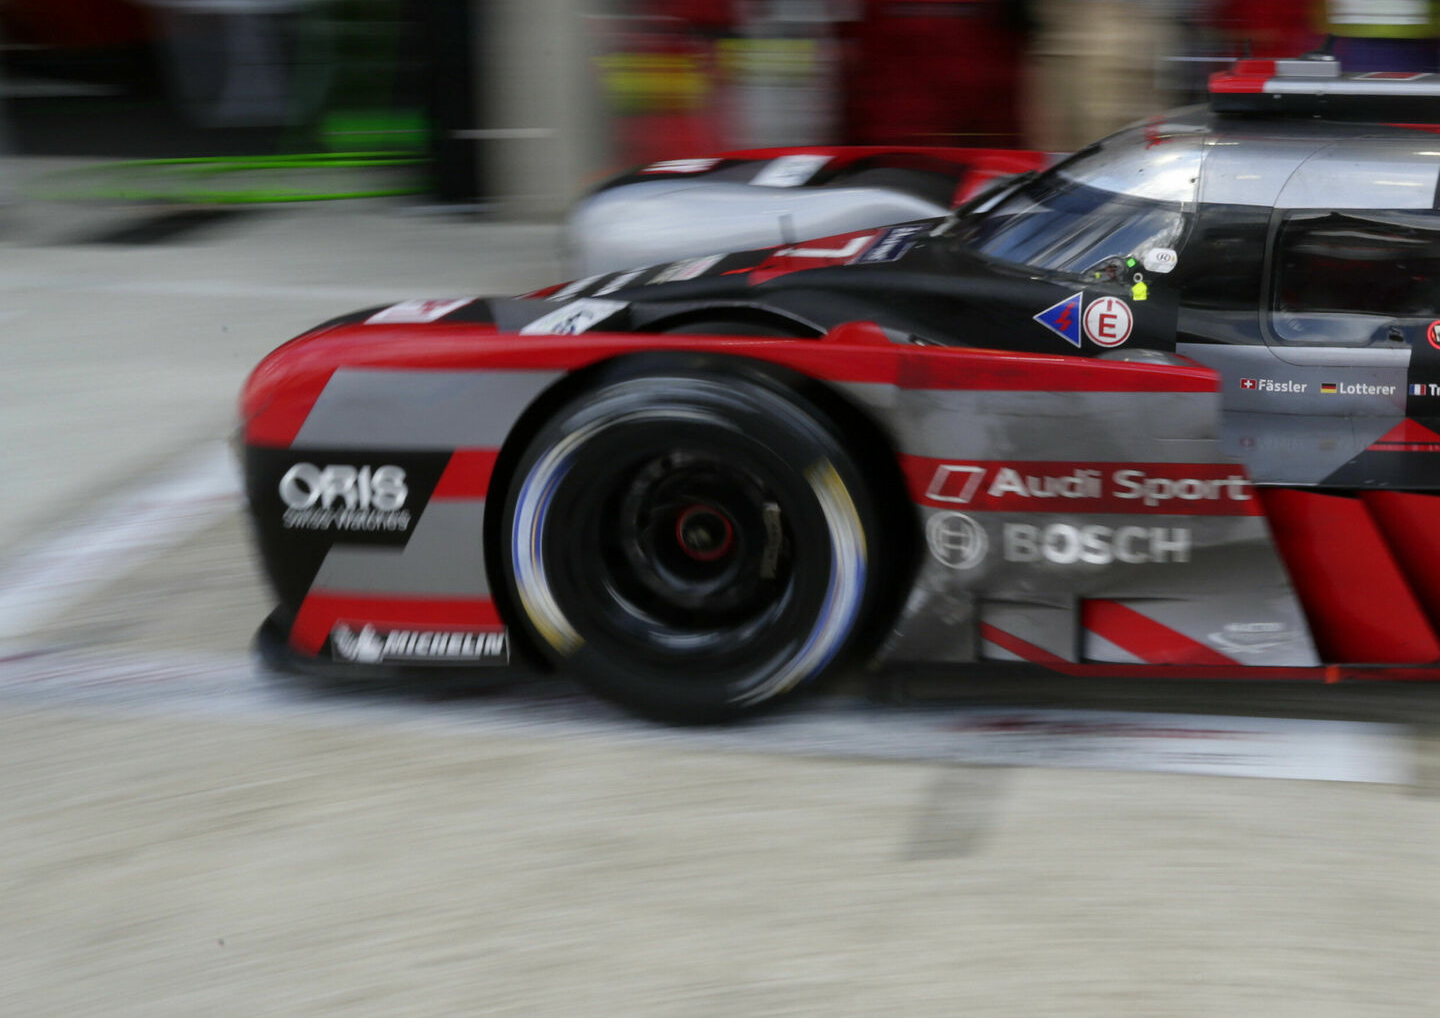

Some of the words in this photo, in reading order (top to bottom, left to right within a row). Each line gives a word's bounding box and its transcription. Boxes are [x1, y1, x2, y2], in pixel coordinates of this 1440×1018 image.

[1099, 314, 1117, 338] E
[1258, 378, 1307, 393] Fässler
[1340, 382, 1396, 396] Lotterer
[279, 462, 408, 510] ORIS
[988, 467, 1102, 498] Audi
[1112, 469, 1252, 506] Sport
[1003, 523, 1190, 565] BOSCH
[382, 630, 505, 657] MICHELIN
